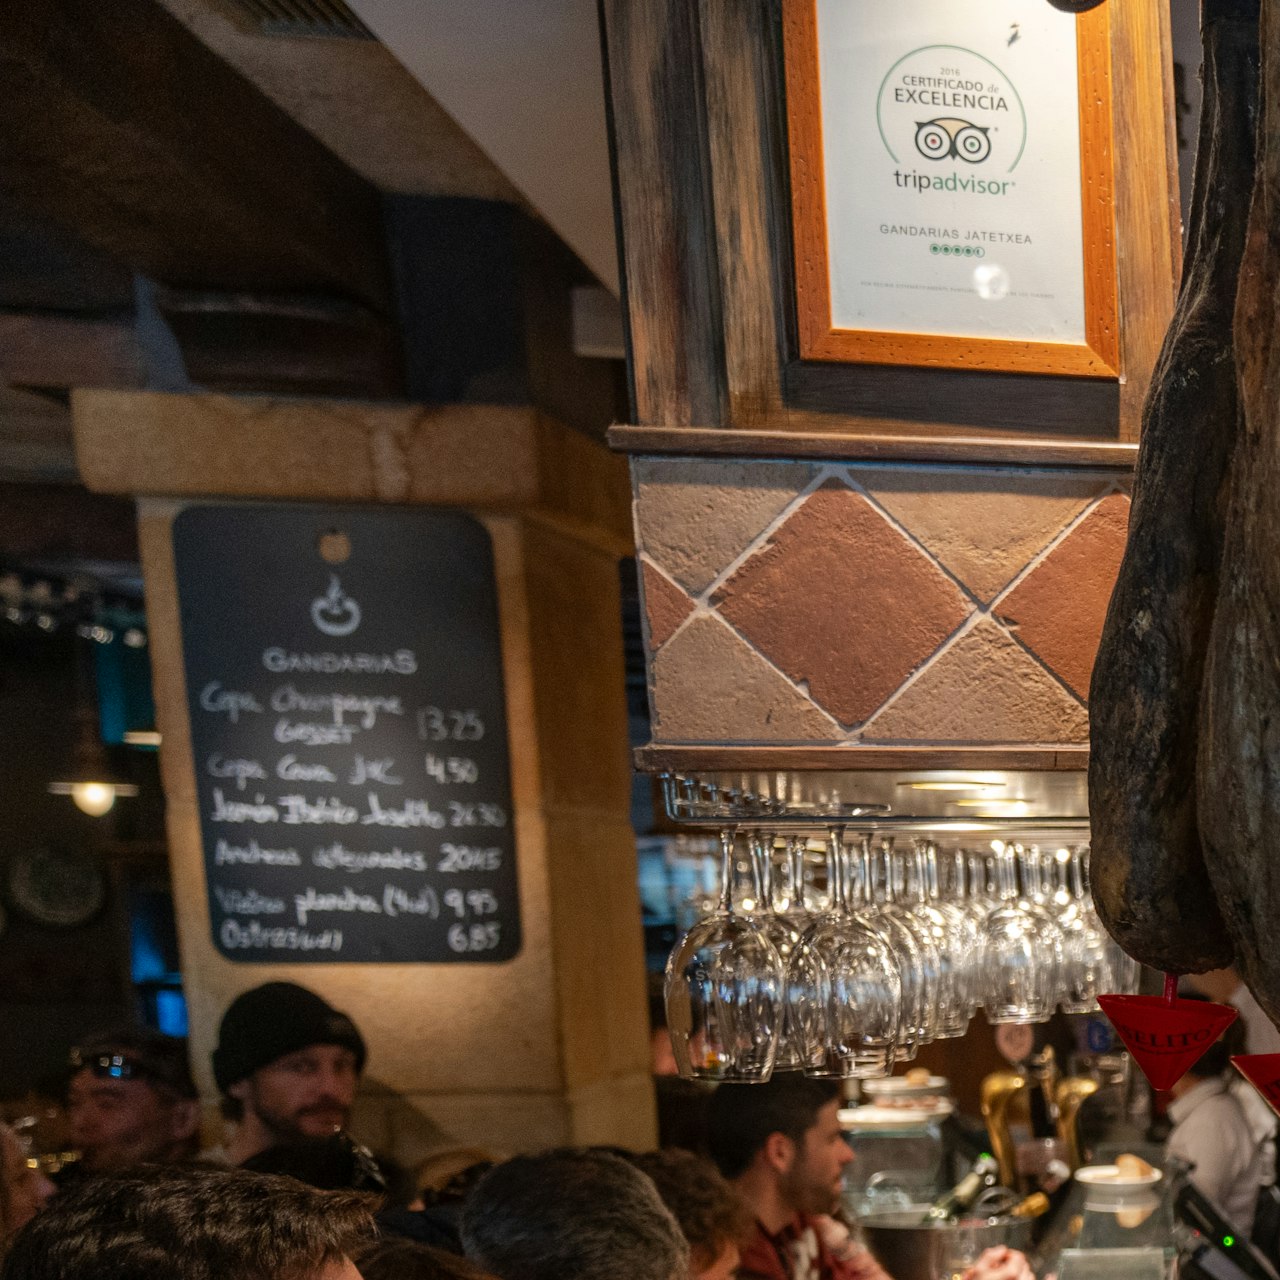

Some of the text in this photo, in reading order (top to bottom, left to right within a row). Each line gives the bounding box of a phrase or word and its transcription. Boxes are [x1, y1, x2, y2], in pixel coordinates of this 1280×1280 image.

[940, 67, 960, 77] 2016
[901, 75, 999, 94] CERTIFICADO de
[894, 87, 1009, 112] EXCELENCIA
[893, 169, 1010, 196] tripadvisor
[879, 224, 1032, 245] GANDARIAS JATETXEA
